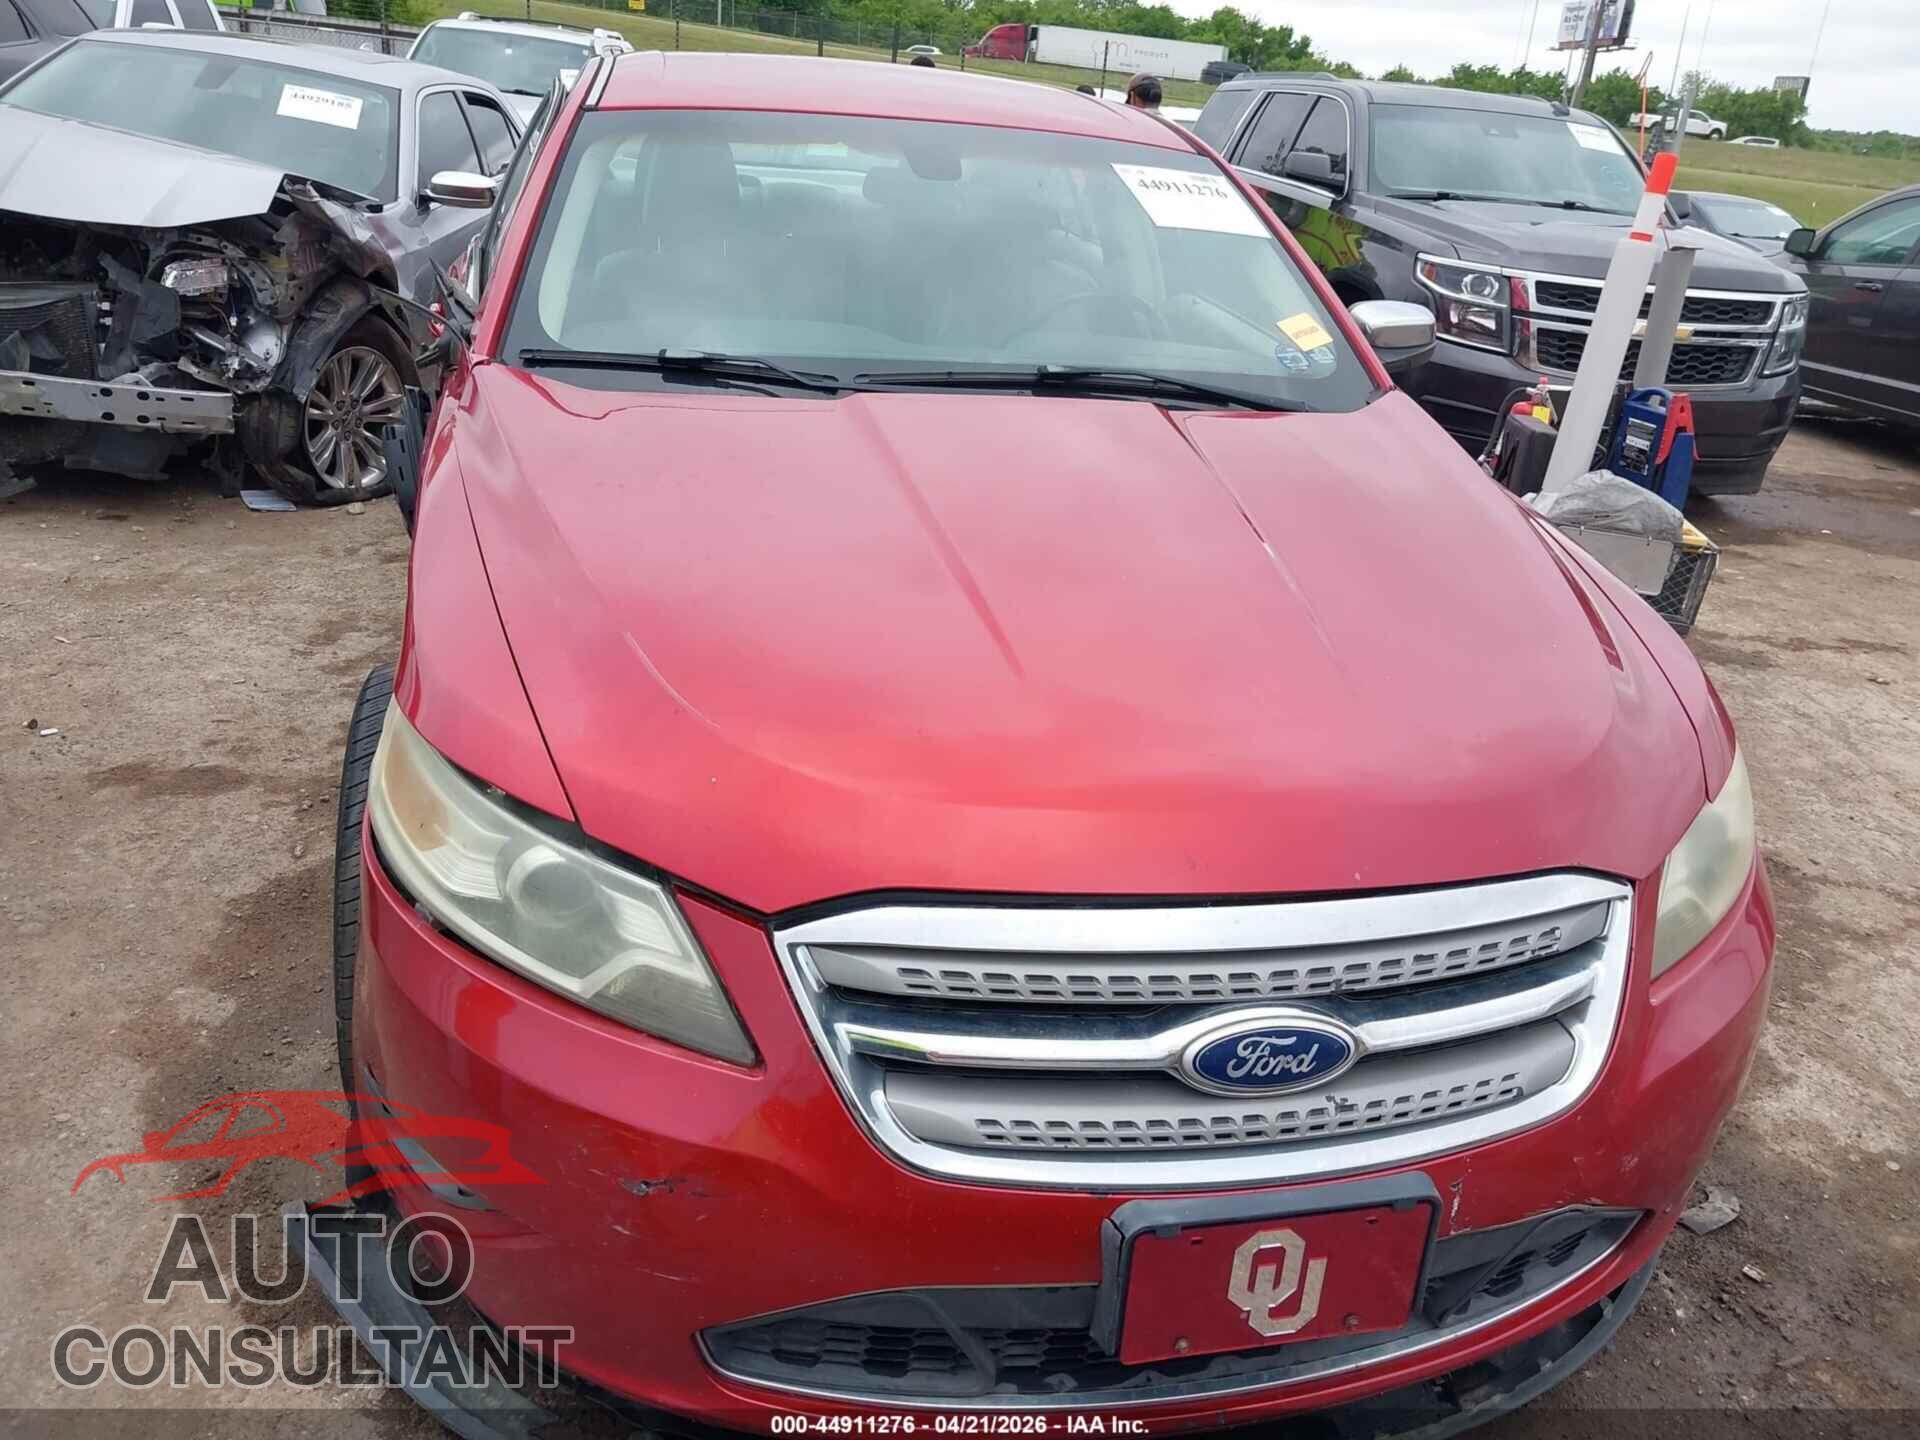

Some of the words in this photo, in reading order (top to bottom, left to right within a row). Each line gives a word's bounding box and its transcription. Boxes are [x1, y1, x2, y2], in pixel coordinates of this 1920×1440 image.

[1138, 178, 1229, 199] 44911276
[1226, 1036, 1320, 1079] Ford
[1227, 1228, 1328, 1337] OU
